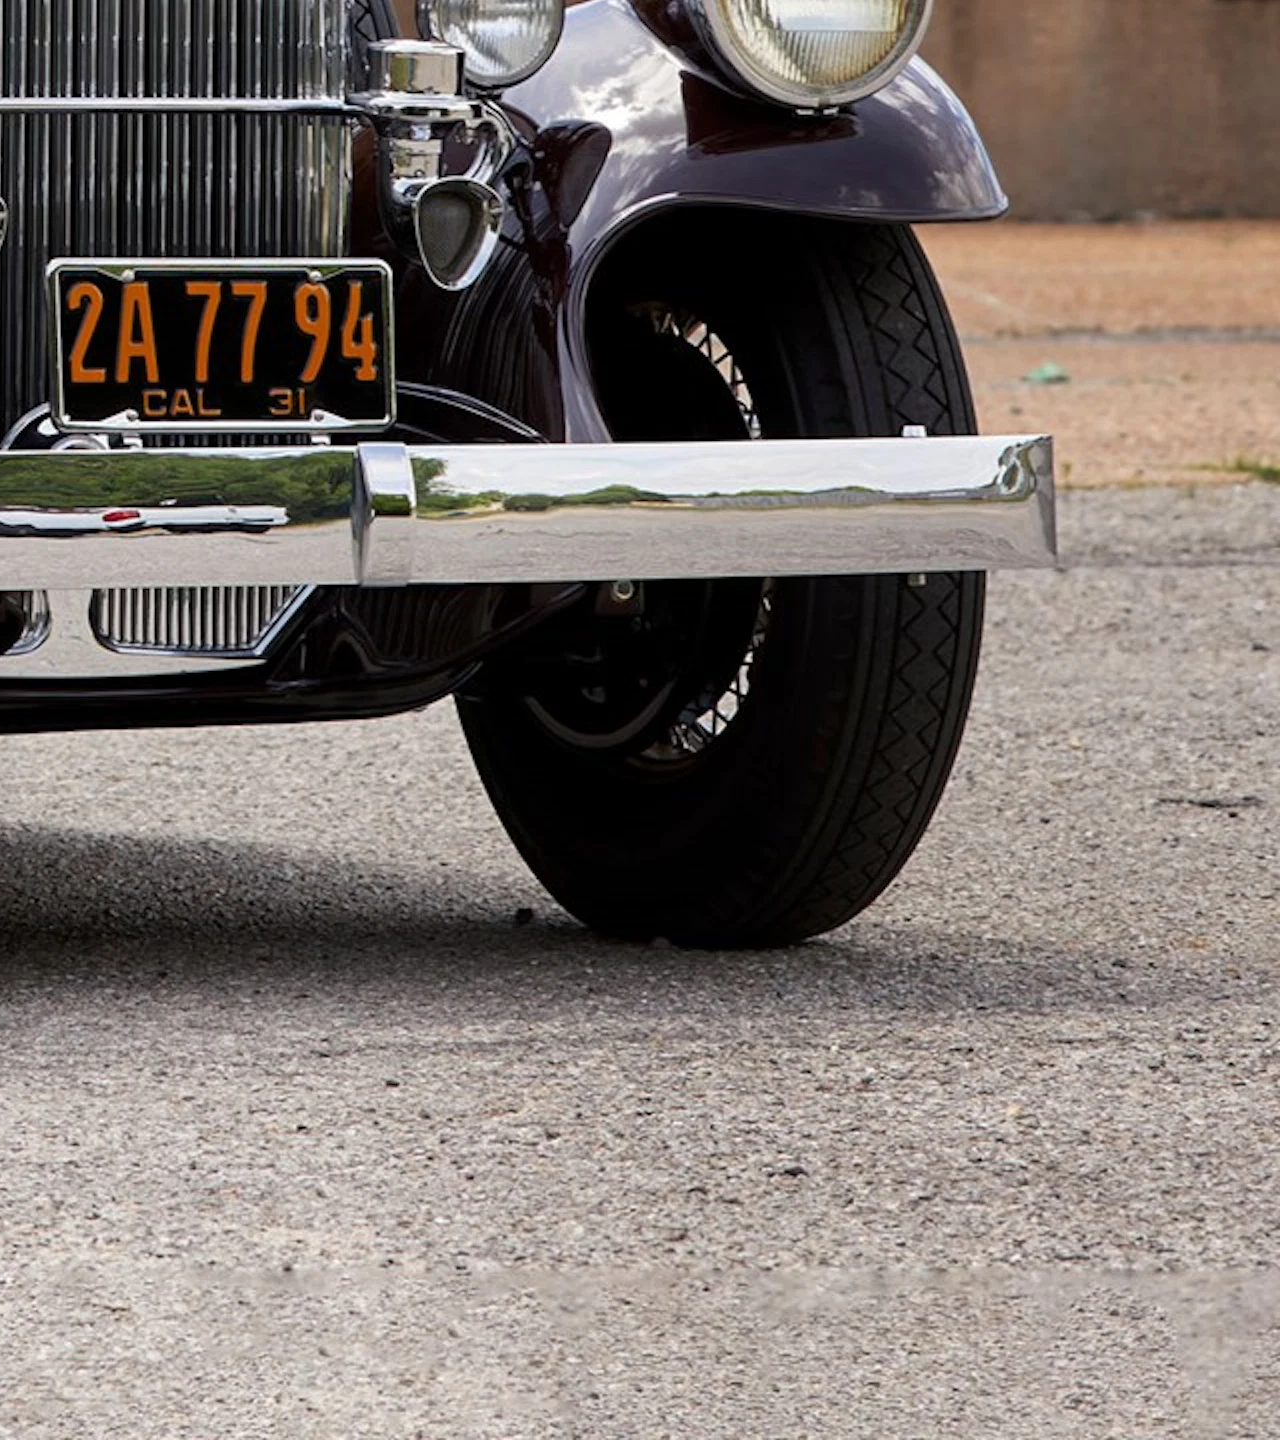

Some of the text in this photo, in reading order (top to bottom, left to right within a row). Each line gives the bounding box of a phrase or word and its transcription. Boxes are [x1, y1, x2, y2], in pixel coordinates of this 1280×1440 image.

[66, 280, 378, 384] 2A 77 94
[142, 388, 307, 417] CAL 31
